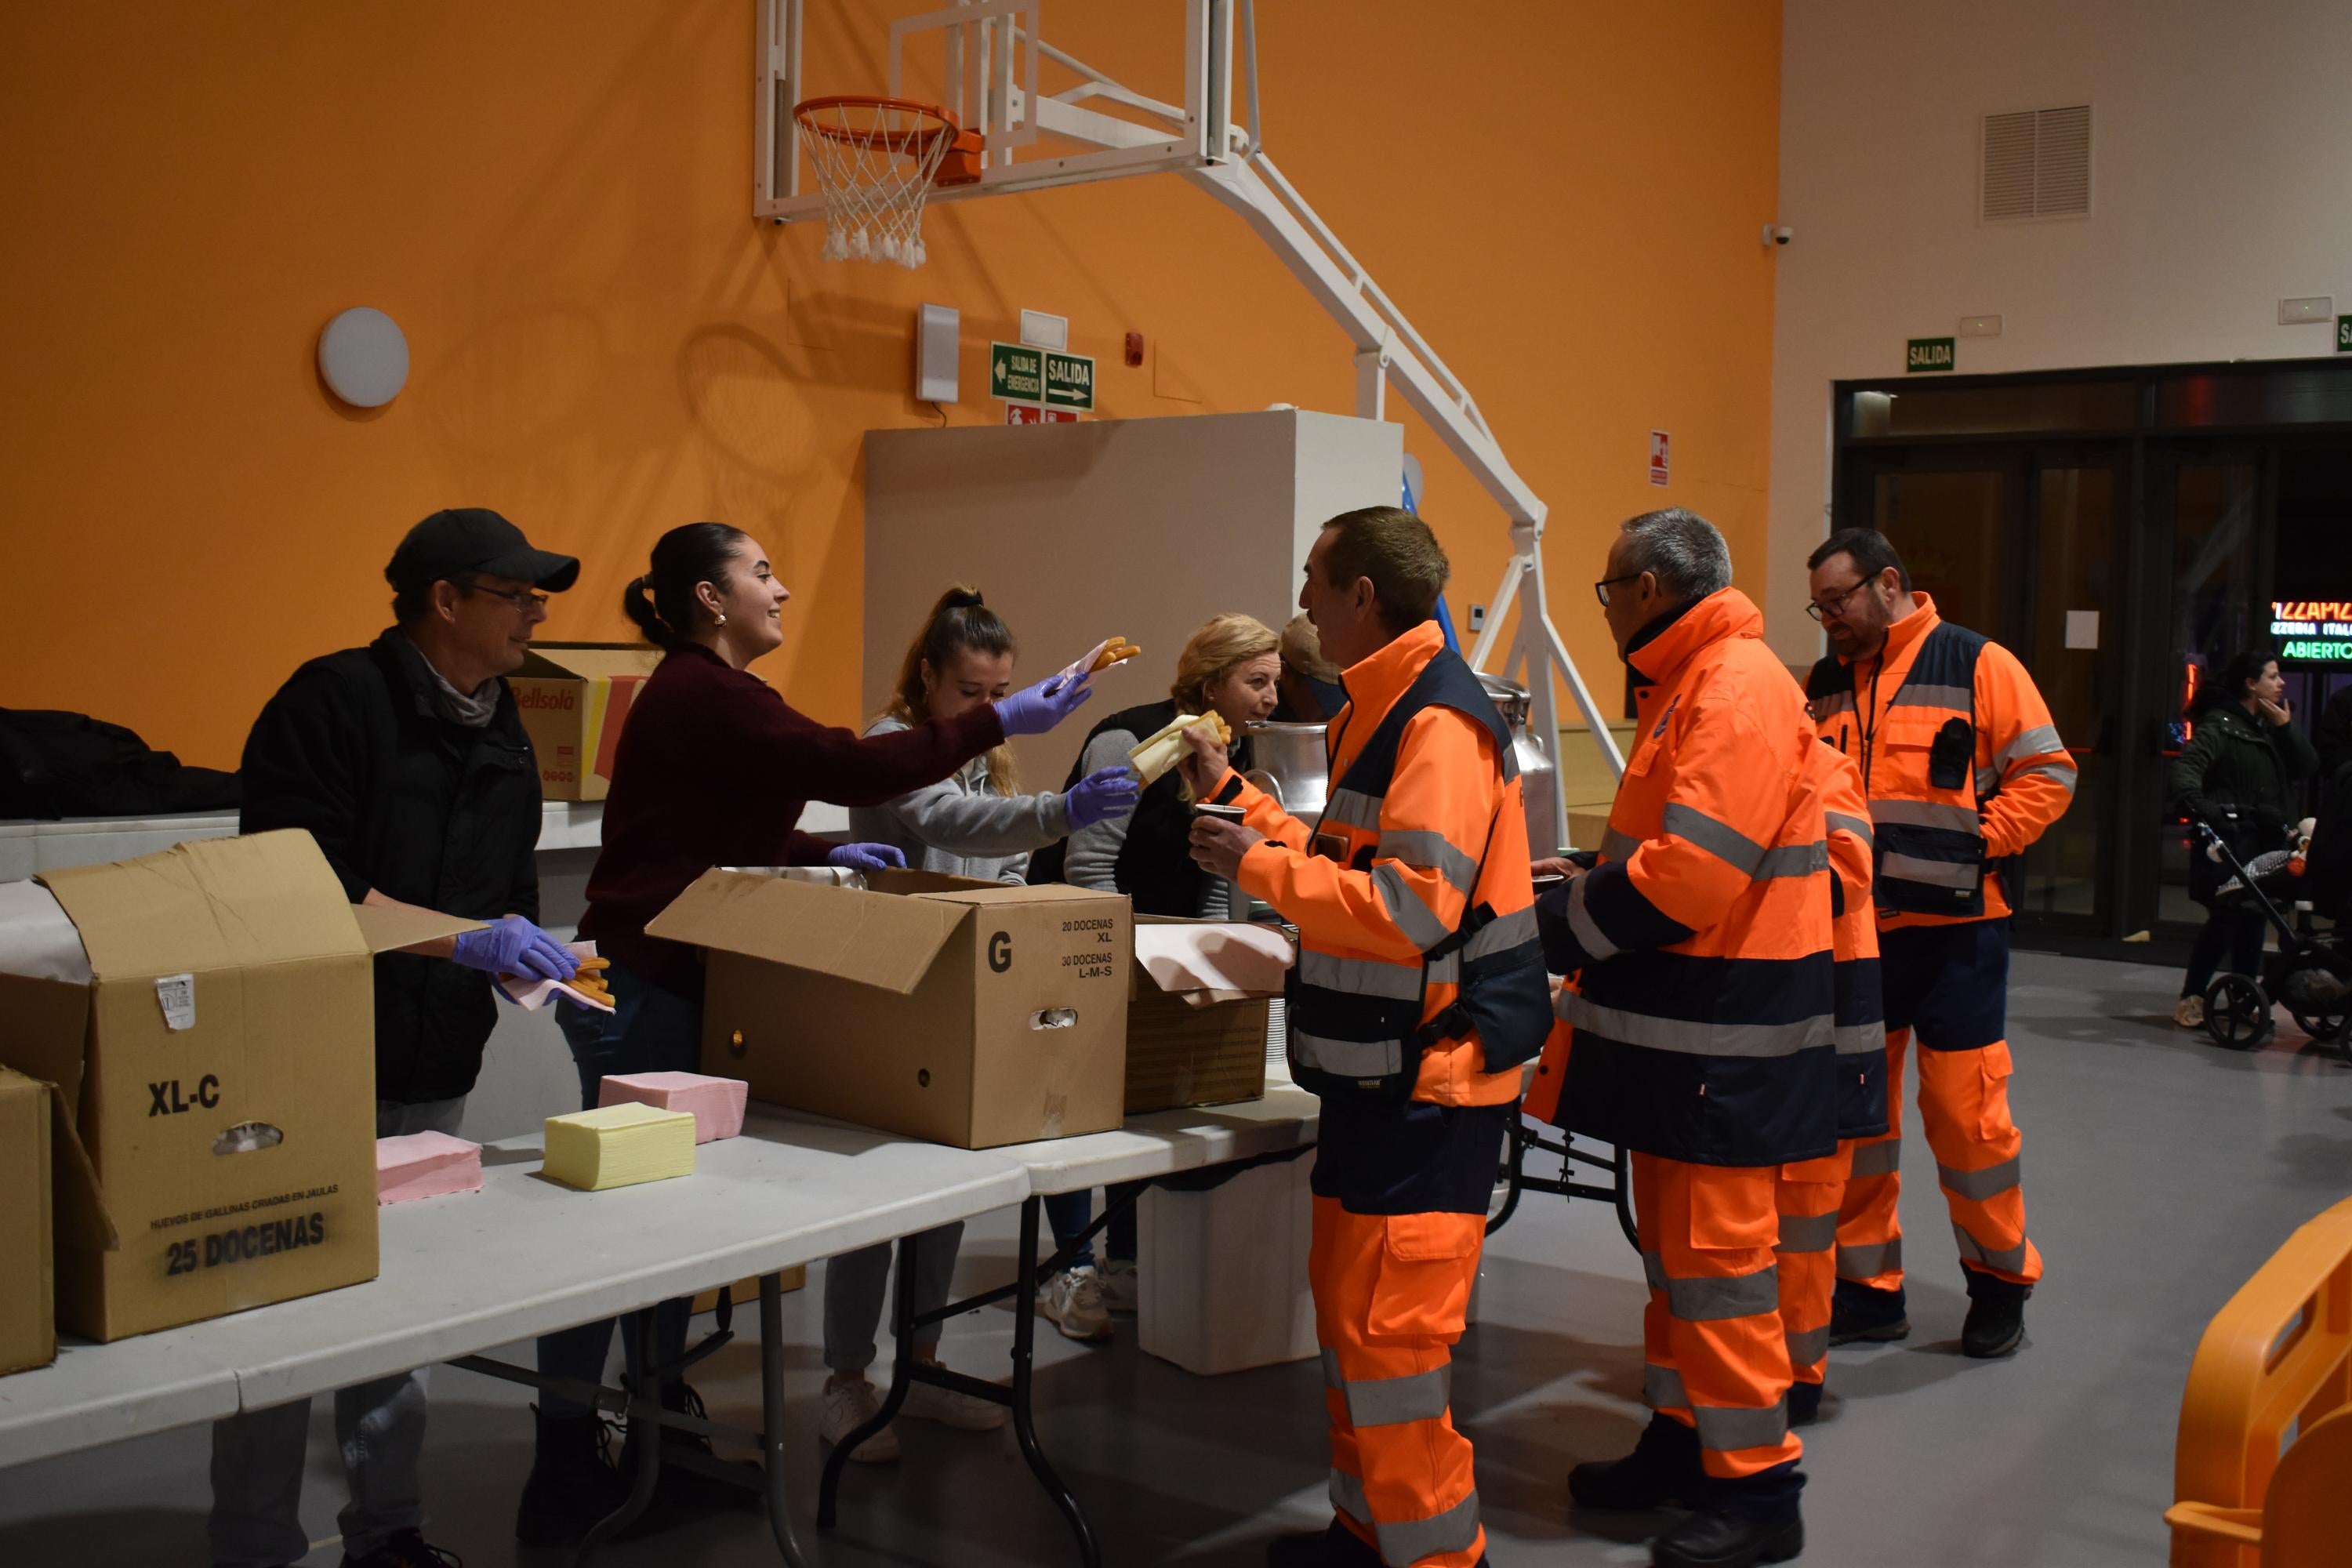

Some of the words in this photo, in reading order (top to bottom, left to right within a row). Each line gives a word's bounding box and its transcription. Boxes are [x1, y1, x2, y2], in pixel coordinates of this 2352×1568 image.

[1011, 355, 1029, 372] SALIDA
[1029, 358, 1037, 374] DE
[1909, 345, 1951, 365] SALIDA
[1048, 359, 1090, 386] SALIDA
[1007, 374, 1040, 394] EMERGENCIA
[2282, 641, 2352, 659] ABIERTO
[1062, 921, 1072, 932] 20
[1073, 918, 1113, 931] DOCENAS
[1097, 932, 1112, 943] XL
[988, 931, 1011, 973] G
[1062, 956, 1072, 967] 30
[1073, 953, 1112, 966] DOCENAS
[1079, 966, 1112, 978] L-M-S
[148, 1073, 220, 1118] XL-C
[151, 1214, 188, 1230] HUEVOS
[190, 1211, 203, 1221] DE
[205, 1202, 250, 1219] GALLINAS
[252, 1193, 291, 1210] CRIADAS
[292, 1192, 305, 1201] EN
[305, 1184, 339, 1199] JAULAS
[166, 1238, 197, 1276] 25
[205, 1212, 325, 1268] DOCENAS
